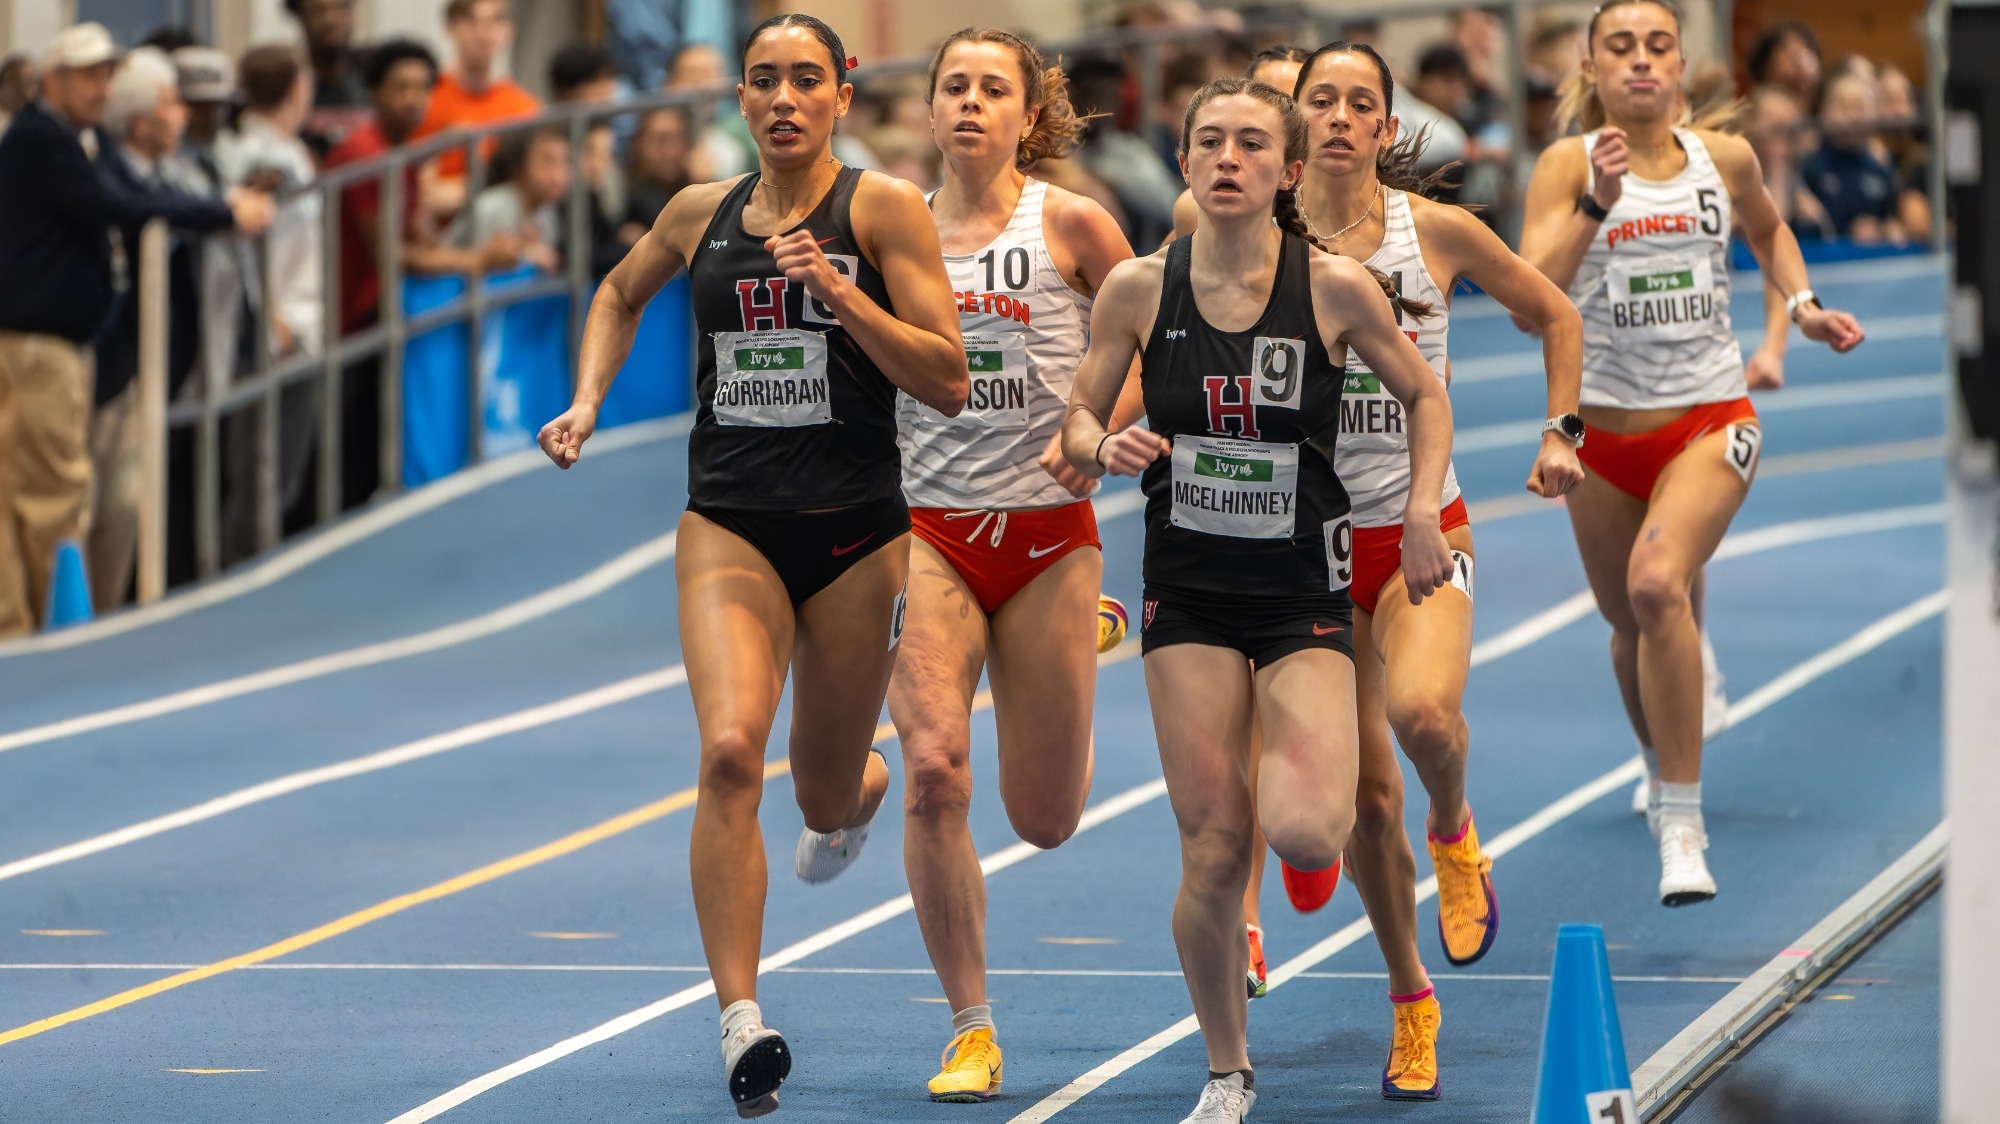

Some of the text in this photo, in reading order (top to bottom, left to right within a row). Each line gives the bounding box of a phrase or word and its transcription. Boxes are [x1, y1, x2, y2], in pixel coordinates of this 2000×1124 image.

[1697, 188, 1721, 236] 5
[708, 239, 722, 250] Ivy
[978, 247, 1030, 292] 10
[1646, 274, 1668, 291] Ivy
[735, 277, 789, 332] H
[1613, 293, 1712, 329] BEAULIEU
[1165, 329, 1179, 340] Ivy
[750, 350, 772, 368] Ivy
[1260, 342, 1298, 403] 9
[717, 377, 827, 407] GORRIARAN
[1203, 375, 1261, 441] H
[1733, 426, 1757, 469] 5
[1214, 458, 1240, 478] Ivy
[1175, 480, 1293, 516] MCELHINNEY
[1332, 519, 1352, 583] 9
[1600, 1096, 1625, 1124] 1
